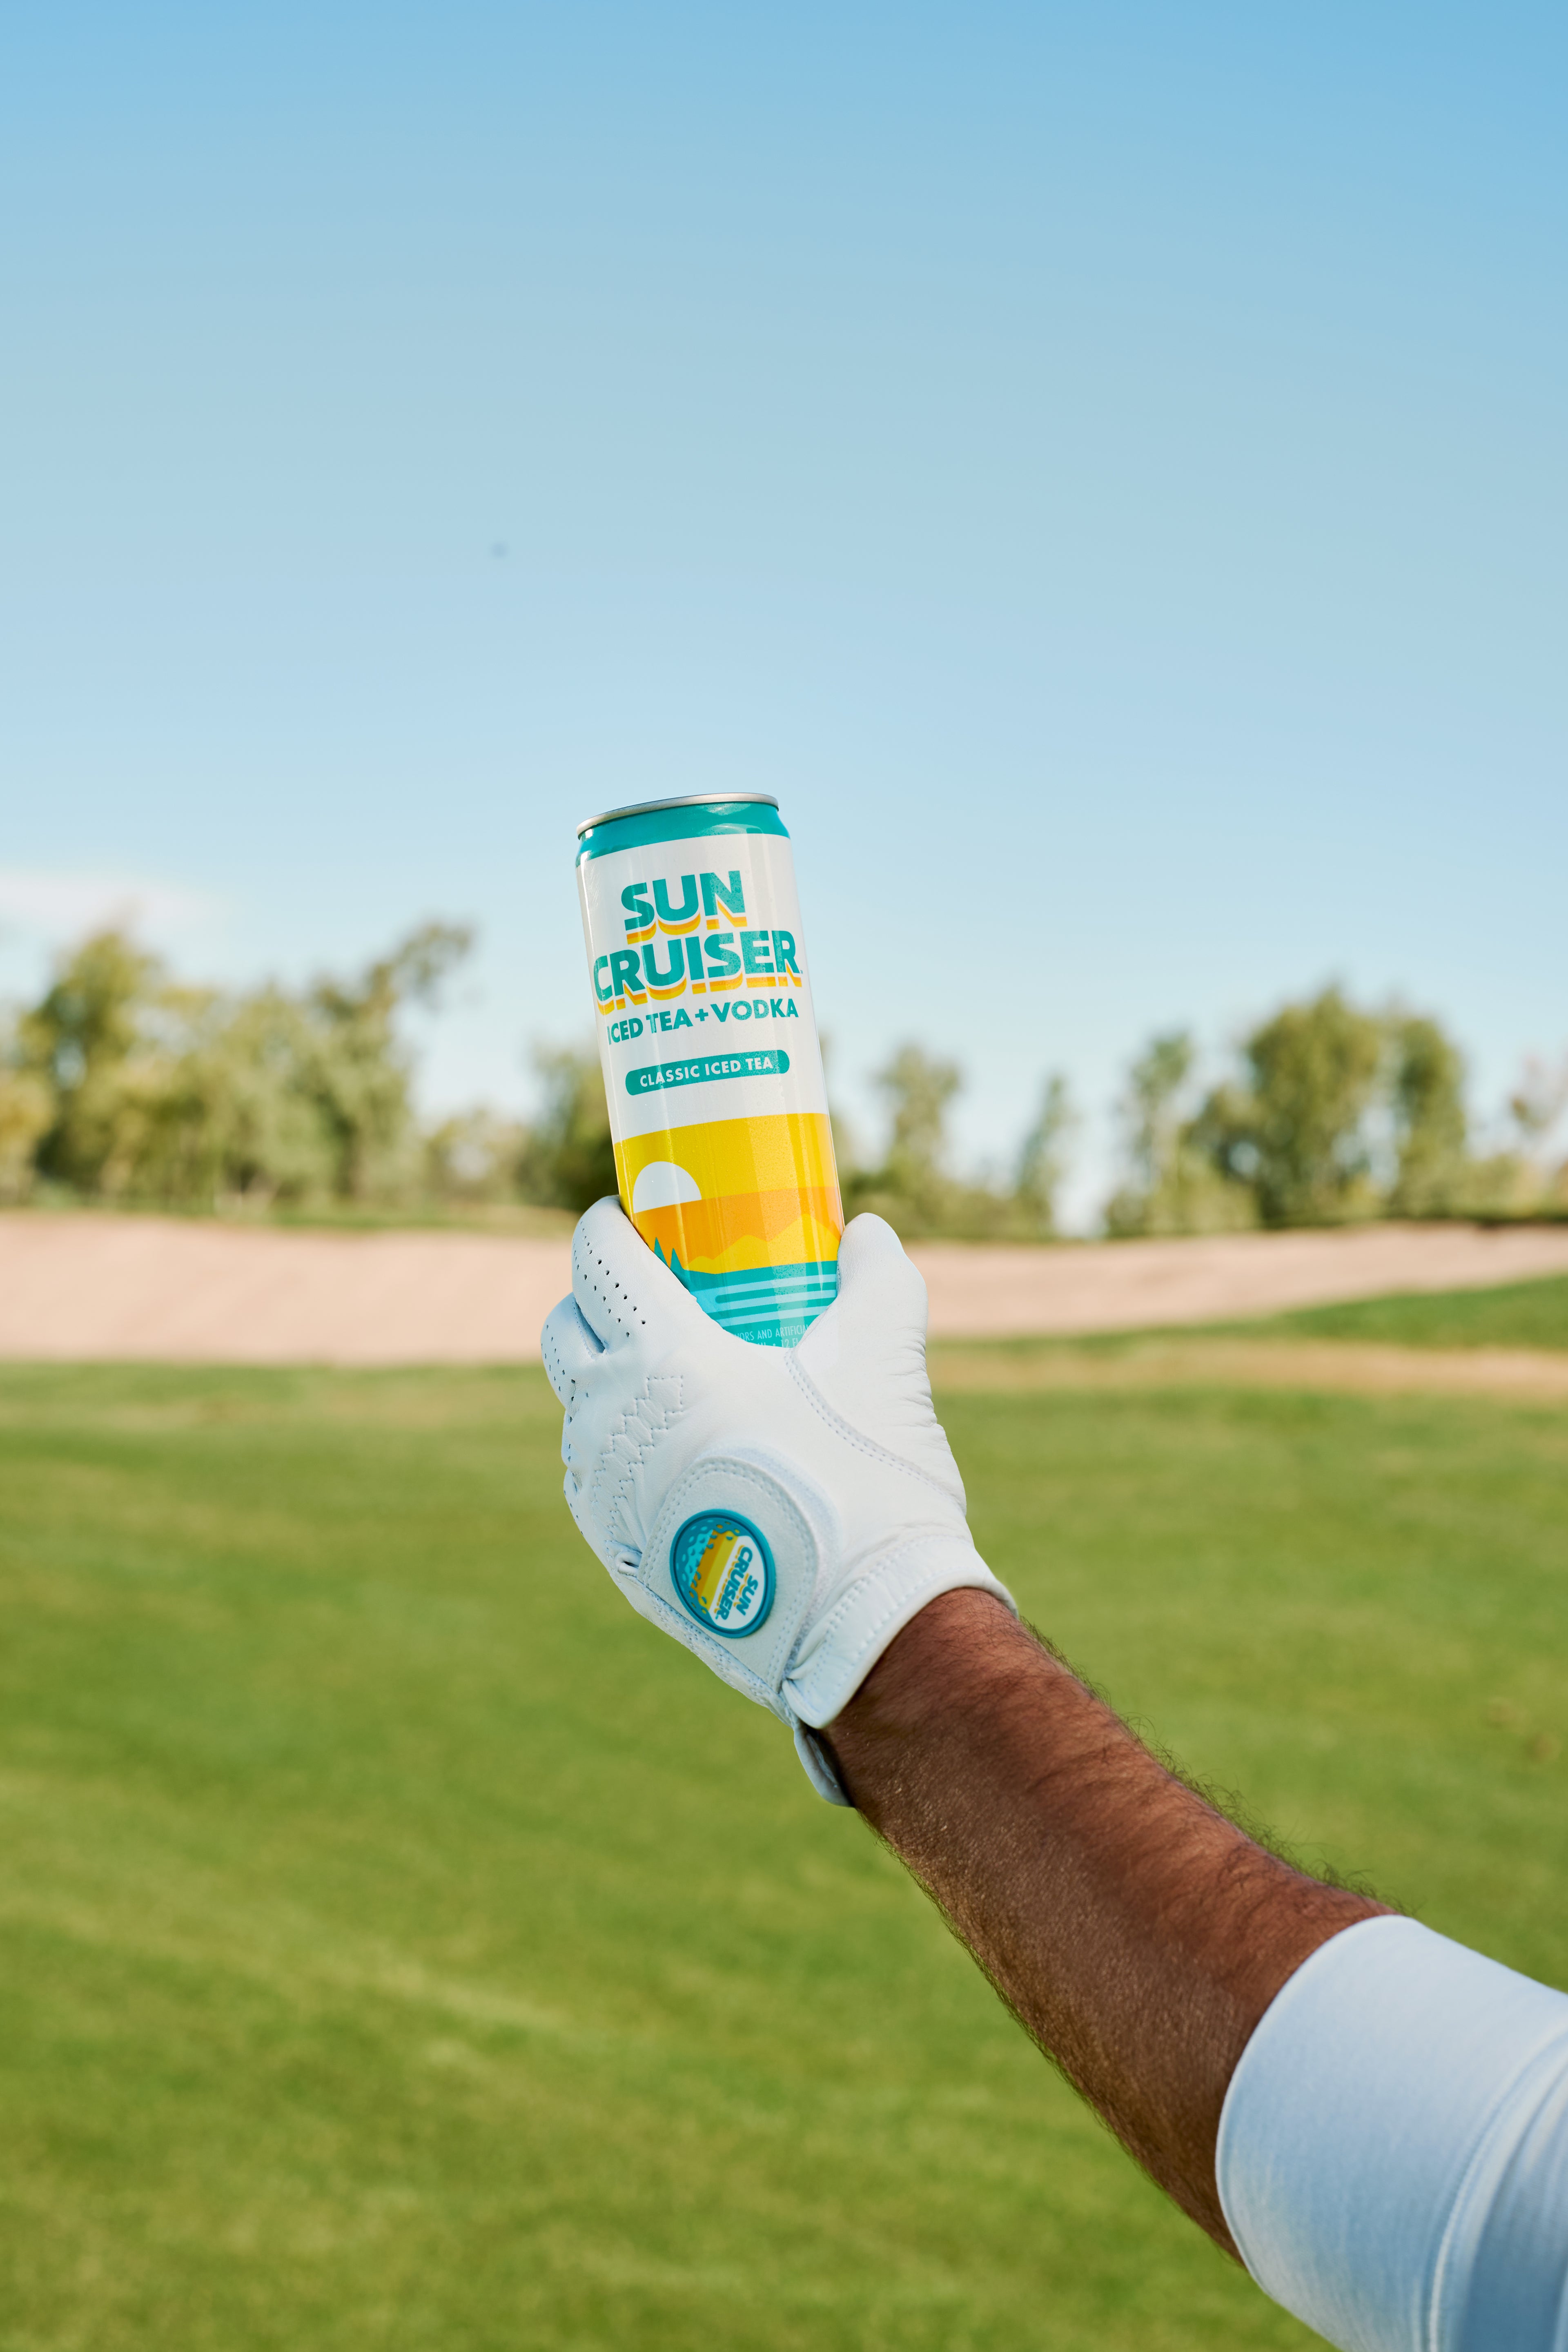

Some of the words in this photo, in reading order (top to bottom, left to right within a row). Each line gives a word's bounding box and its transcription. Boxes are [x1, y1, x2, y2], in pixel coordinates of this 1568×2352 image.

[621, 870, 745, 931] SUN
[593, 930, 800, 1002] CRUISER
[606, 1017, 644, 1045] ICED
[639, 1065, 700, 1087] CLASSIC
[705, 1060, 741, 1075] ICED
[745, 1057, 774, 1070] TEA
[757, 1329, 772, 1340] AND
[715, 1546, 753, 1620] CRUISER
[736, 1575, 759, 1616] SUN
